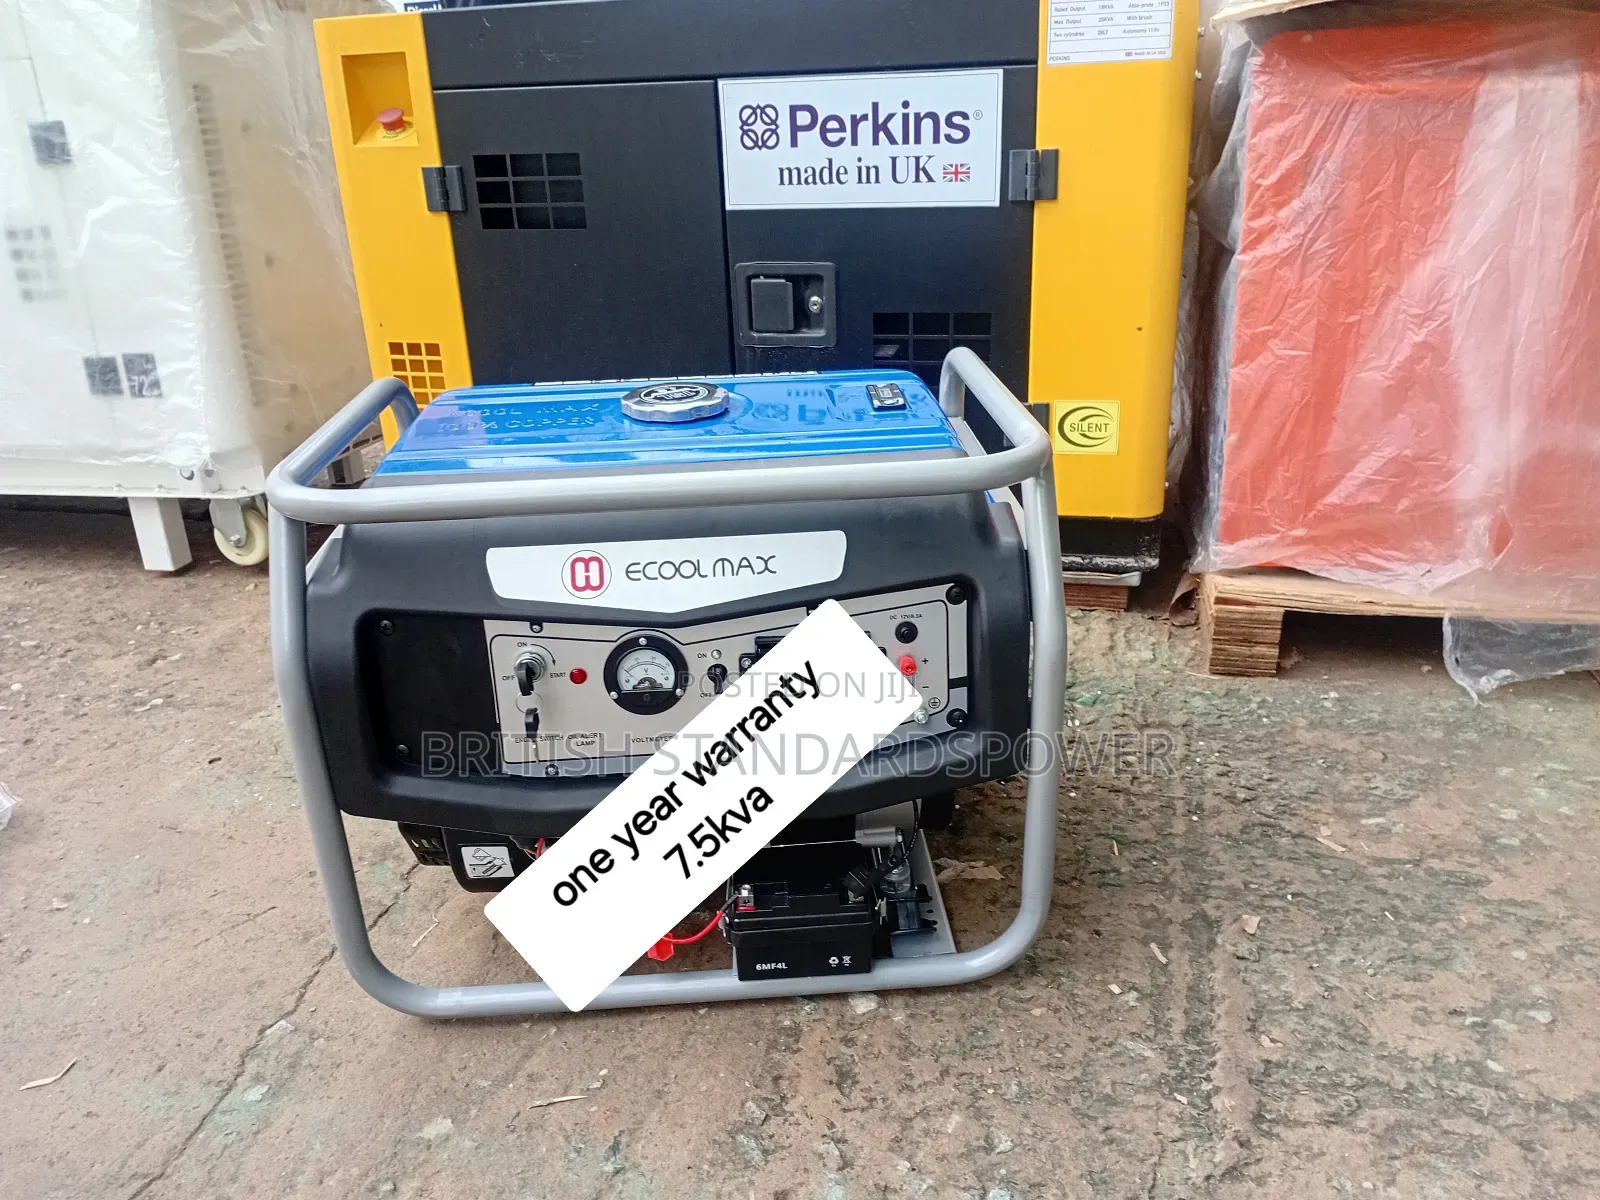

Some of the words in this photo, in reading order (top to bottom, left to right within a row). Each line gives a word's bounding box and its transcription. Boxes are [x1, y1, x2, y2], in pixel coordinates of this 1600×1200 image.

[1122, 27, 1147, 35] Autonomy
[778, 157, 849, 186] made
[855, 156, 881, 185] in
[889, 155, 936, 184] UK
[505, 416, 595, 429] COPPER
[1069, 422, 1110, 433] SILENT
[514, 736, 538, 744] ENG
[539, 734, 564, 742] SWITCH
[755, 962, 788, 971] 6MF4L
